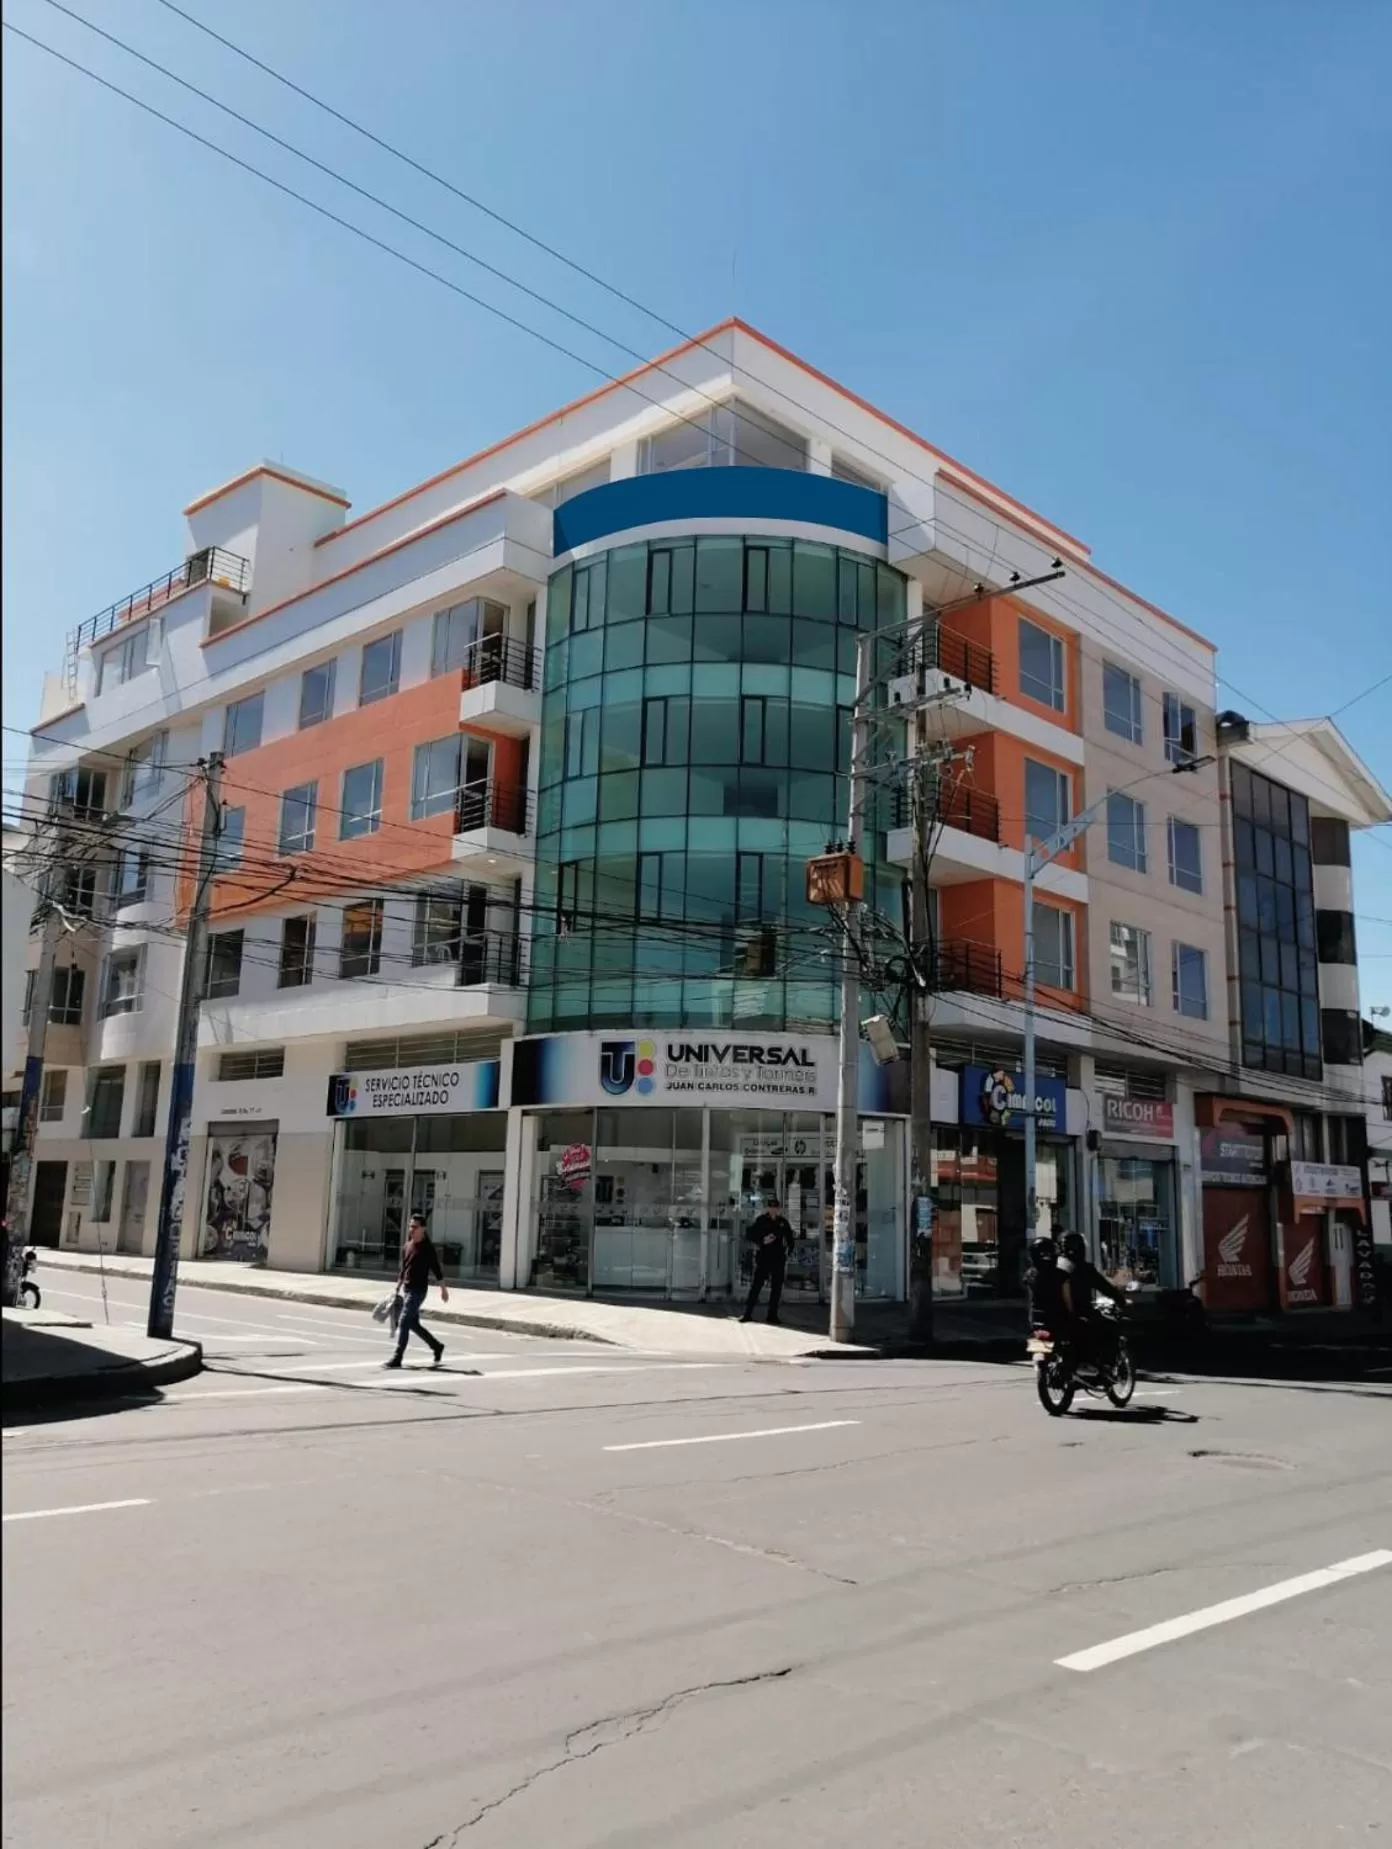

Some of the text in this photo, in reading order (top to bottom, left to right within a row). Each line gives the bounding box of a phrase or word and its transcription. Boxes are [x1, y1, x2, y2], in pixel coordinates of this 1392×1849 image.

[667, 1044, 815, 1066] UNIVERSAL
[666, 1064, 688, 1077] De
[365, 1071, 460, 1092] SERVICIO TÉCNICO
[666, 1081, 694, 1091] JUAN
[698, 1082, 739, 1092] CARLOS
[743, 1083, 805, 1094] CONTRERAS
[372, 1090, 449, 1108] ESPECIALIZADO
[1107, 1099, 1154, 1122] RICOH
[1217, 1264, 1252, 1277] HONDA
